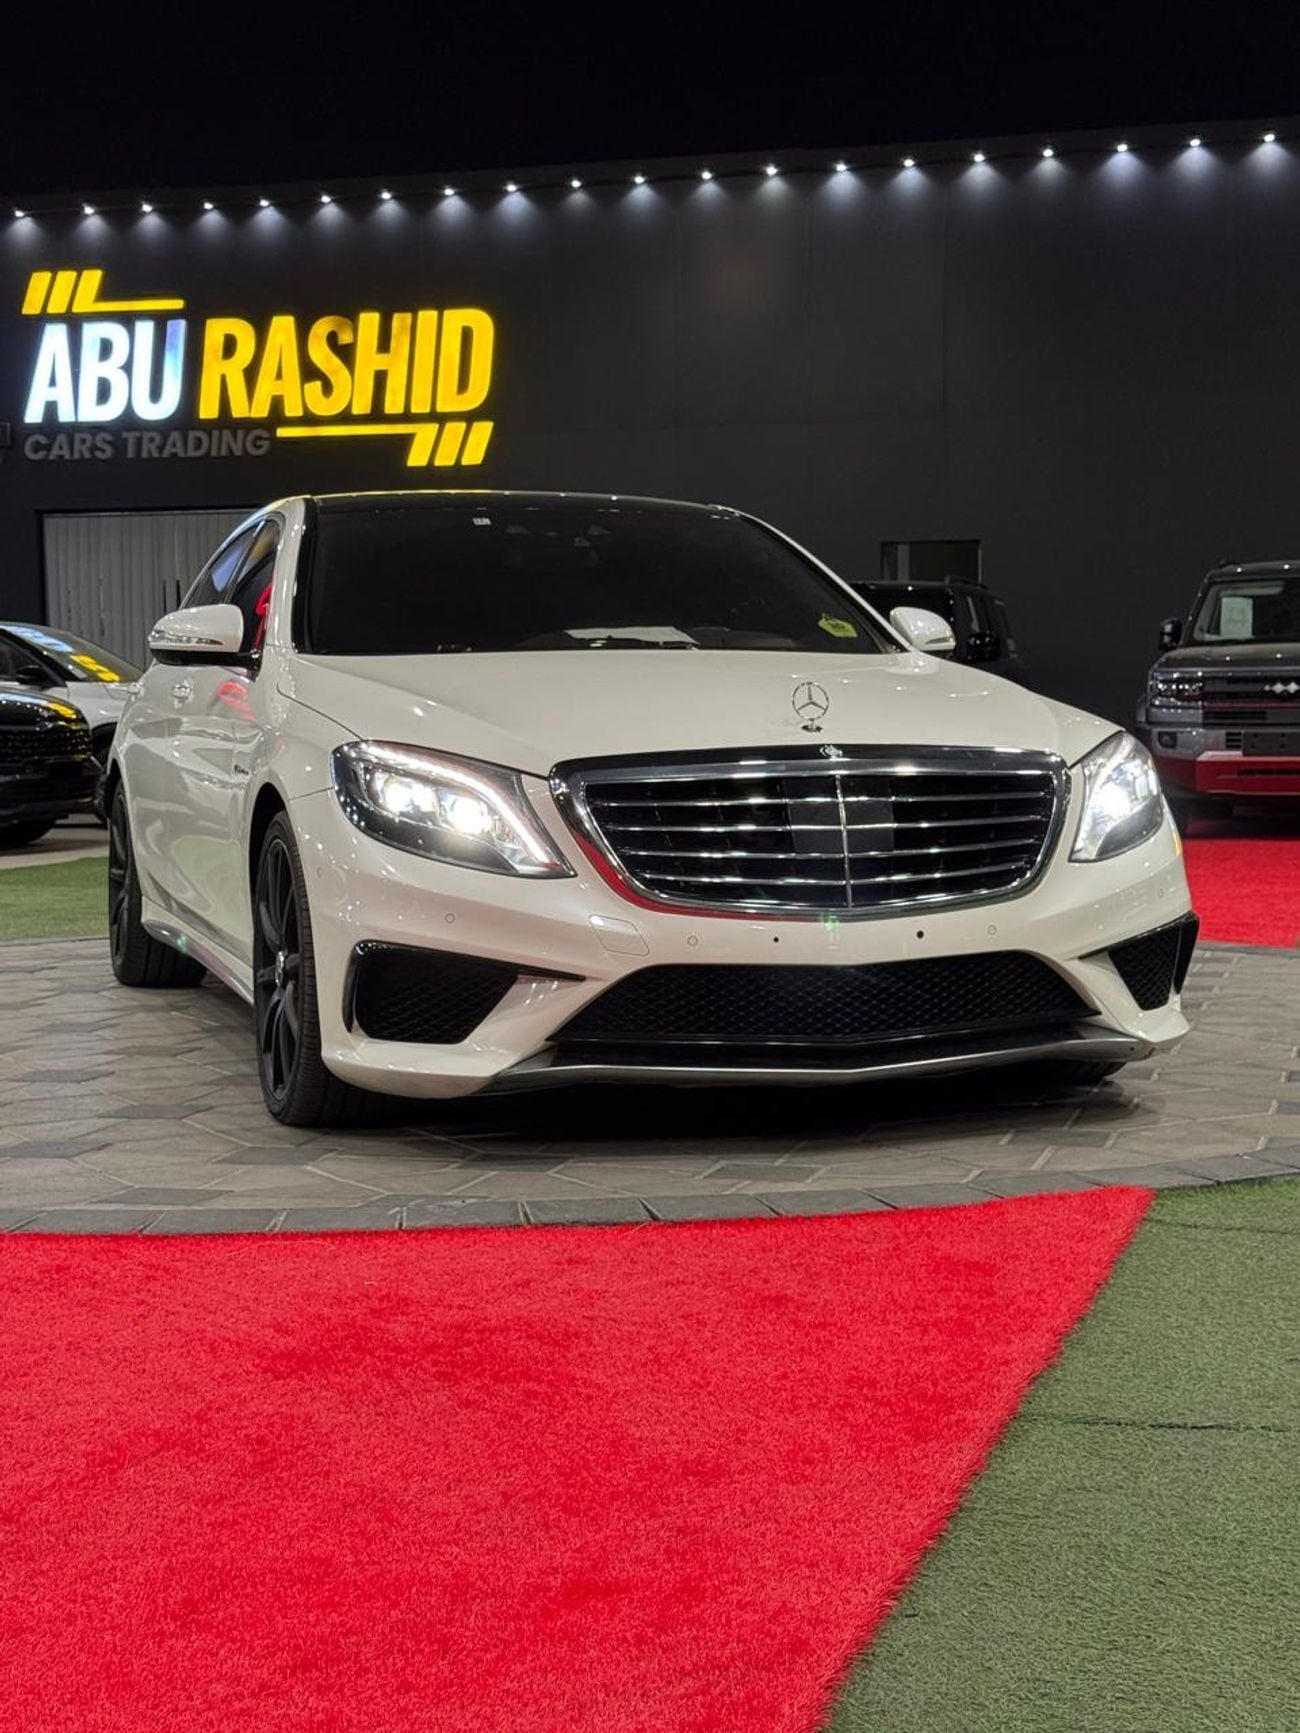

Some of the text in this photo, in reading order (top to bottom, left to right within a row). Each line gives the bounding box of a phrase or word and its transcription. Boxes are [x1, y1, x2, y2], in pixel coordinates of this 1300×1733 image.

[24, 308, 495, 423] ABU RASHID
[23, 428, 271, 460] CARS TRADING
